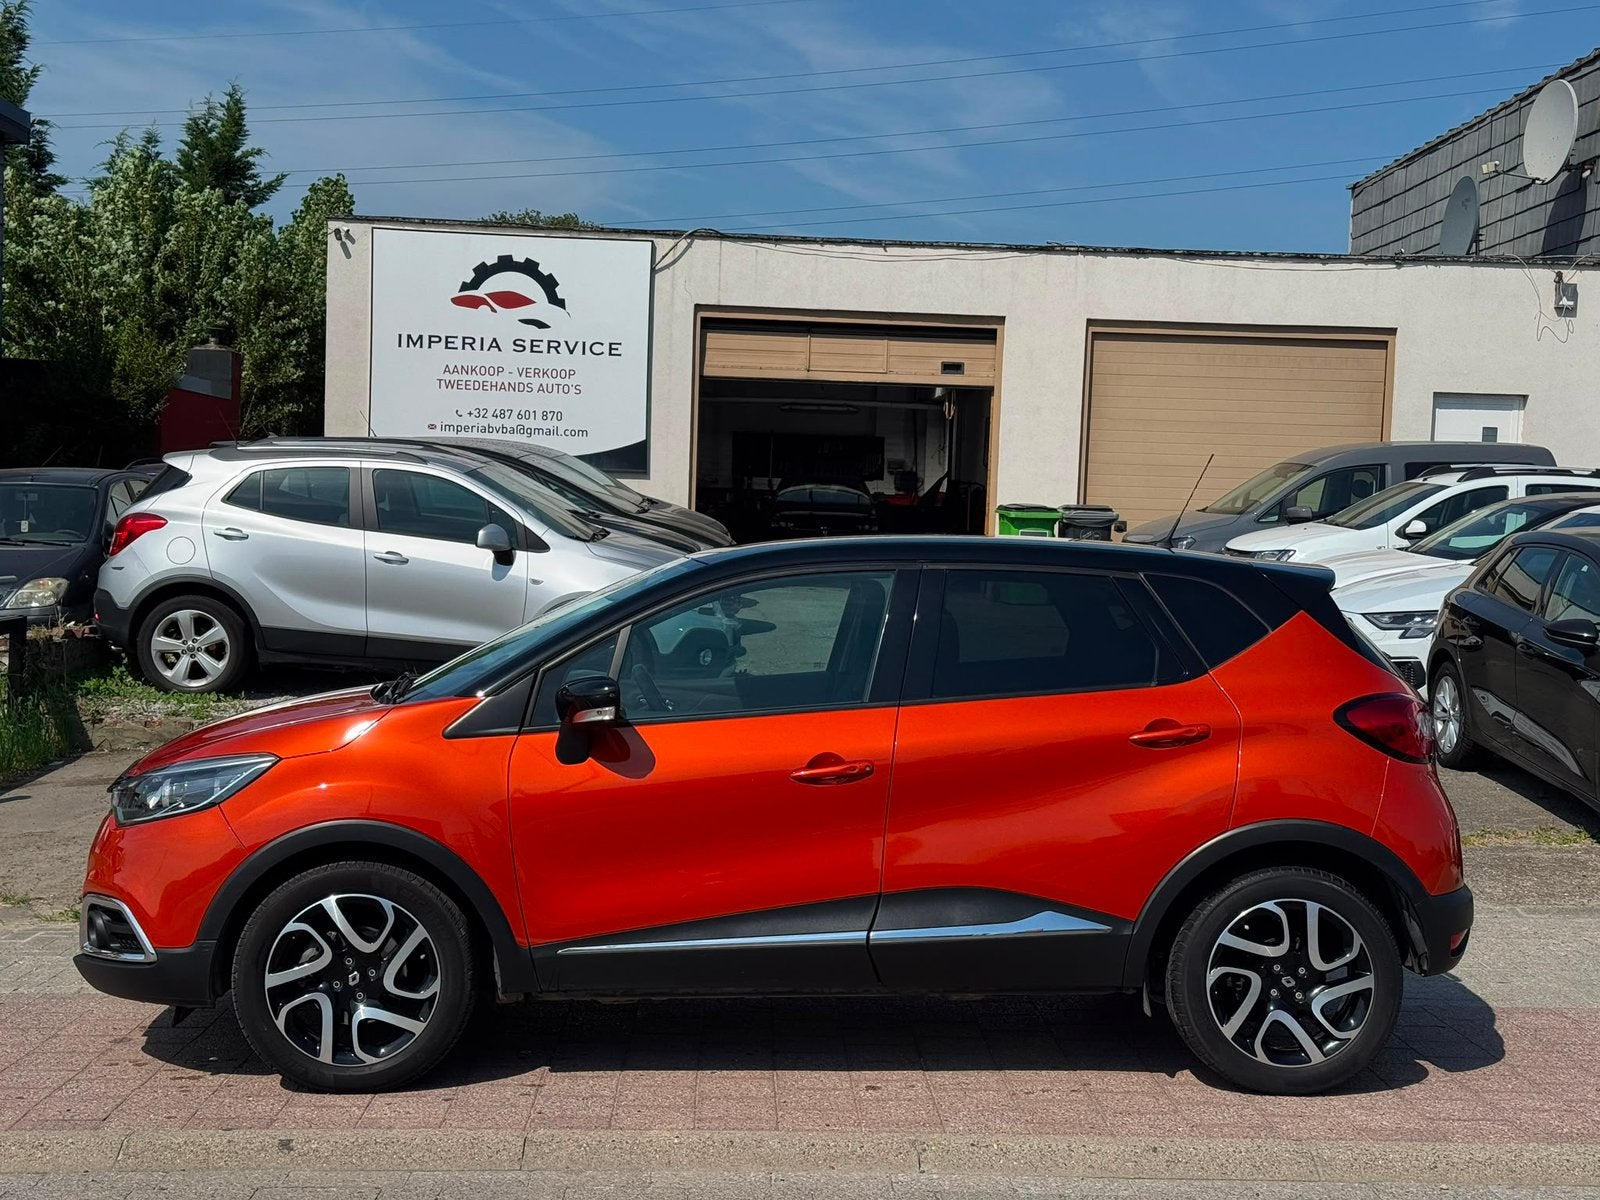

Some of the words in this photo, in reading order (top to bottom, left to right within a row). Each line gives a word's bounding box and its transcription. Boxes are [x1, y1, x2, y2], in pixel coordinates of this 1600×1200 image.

[398, 333, 502, 352] IMPERIA
[512, 338, 622, 356] SERVICE
[443, 364, 504, 377] AANKOOP
[517, 367, 576, 379] VERKOOP
[437, 379, 534, 393] TWEEDEHANDS
[537, 383, 582, 395] AUTO'S
[466, 408, 488, 419] +32
[491, 409, 514, 420] 487
[517, 409, 537, 421] 601
[541, 410, 563, 421] 870
[440, 421, 588, 438] imperiabvba@gmail.com
